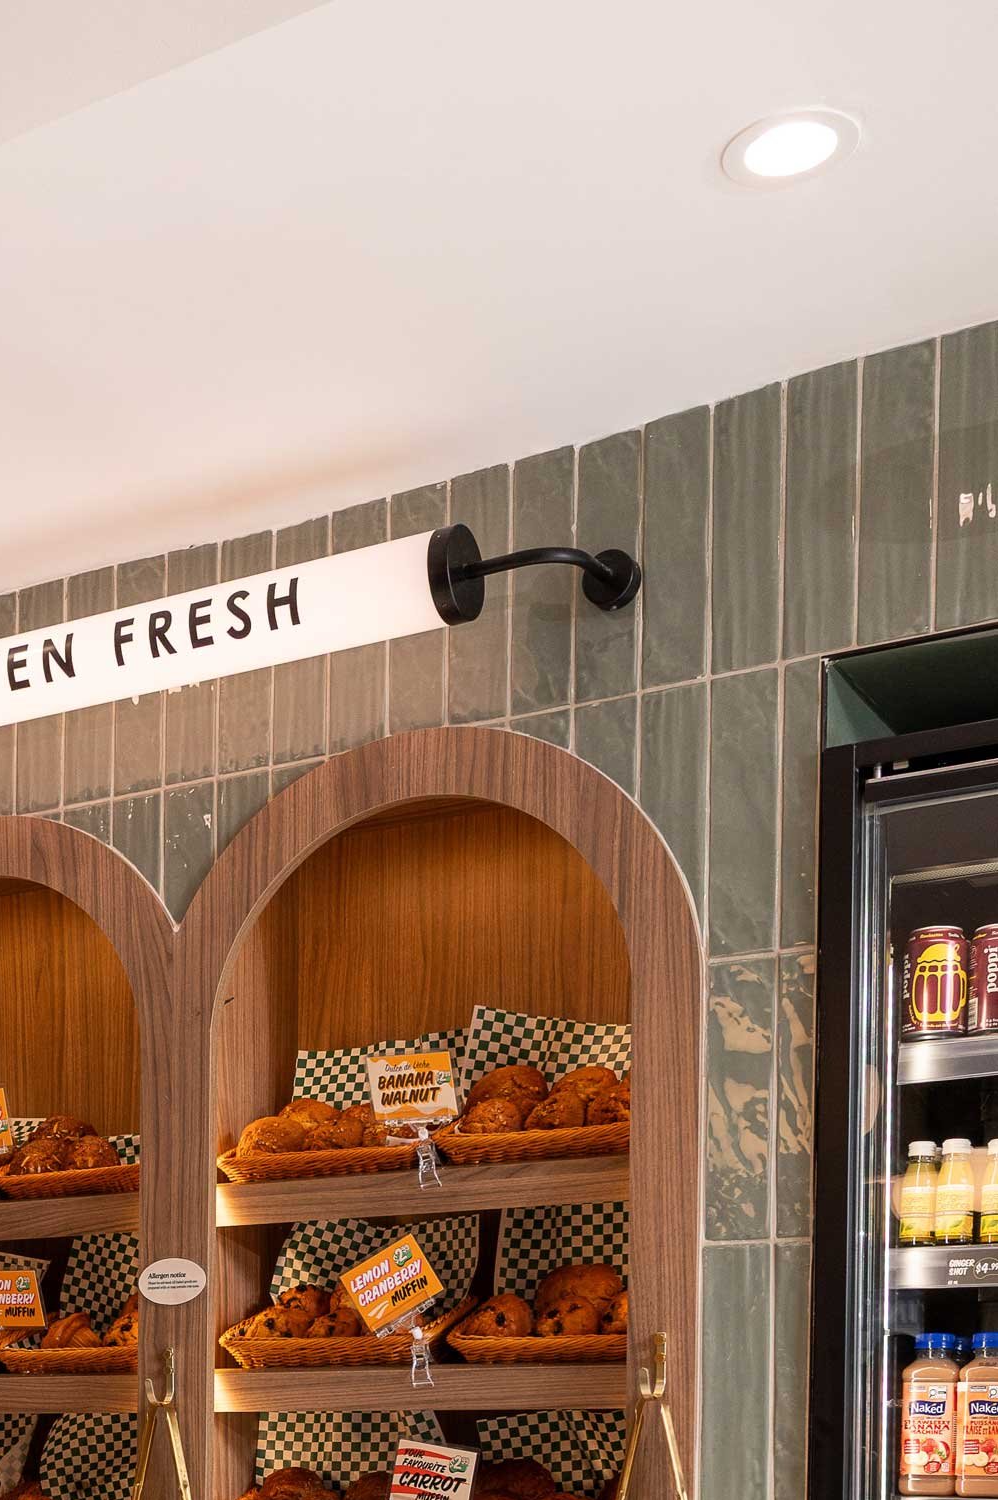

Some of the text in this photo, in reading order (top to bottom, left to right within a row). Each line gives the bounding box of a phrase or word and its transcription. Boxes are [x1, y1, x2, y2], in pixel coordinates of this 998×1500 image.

[113, 577, 301, 667] FRESH
[984, 944, 998, 994] poppi
[378, 1070, 434, 1090] BANANA
[381, 1086, 440, 1106] WALNUT
[948, 1259, 976, 1269] GINGER
[948, 1267, 968, 1276] SHOT
[349, 1258, 390, 1294] LEMON
[358, 1258, 421, 1307] CRANBERRY
[391, 1275, 428, 1306] MUFFIN
[5, 1307, 35, 1318] MUFFIN
[402, 1458, 447, 1473] FAVOURITE
[399, 1470, 466, 1492] CARROT
